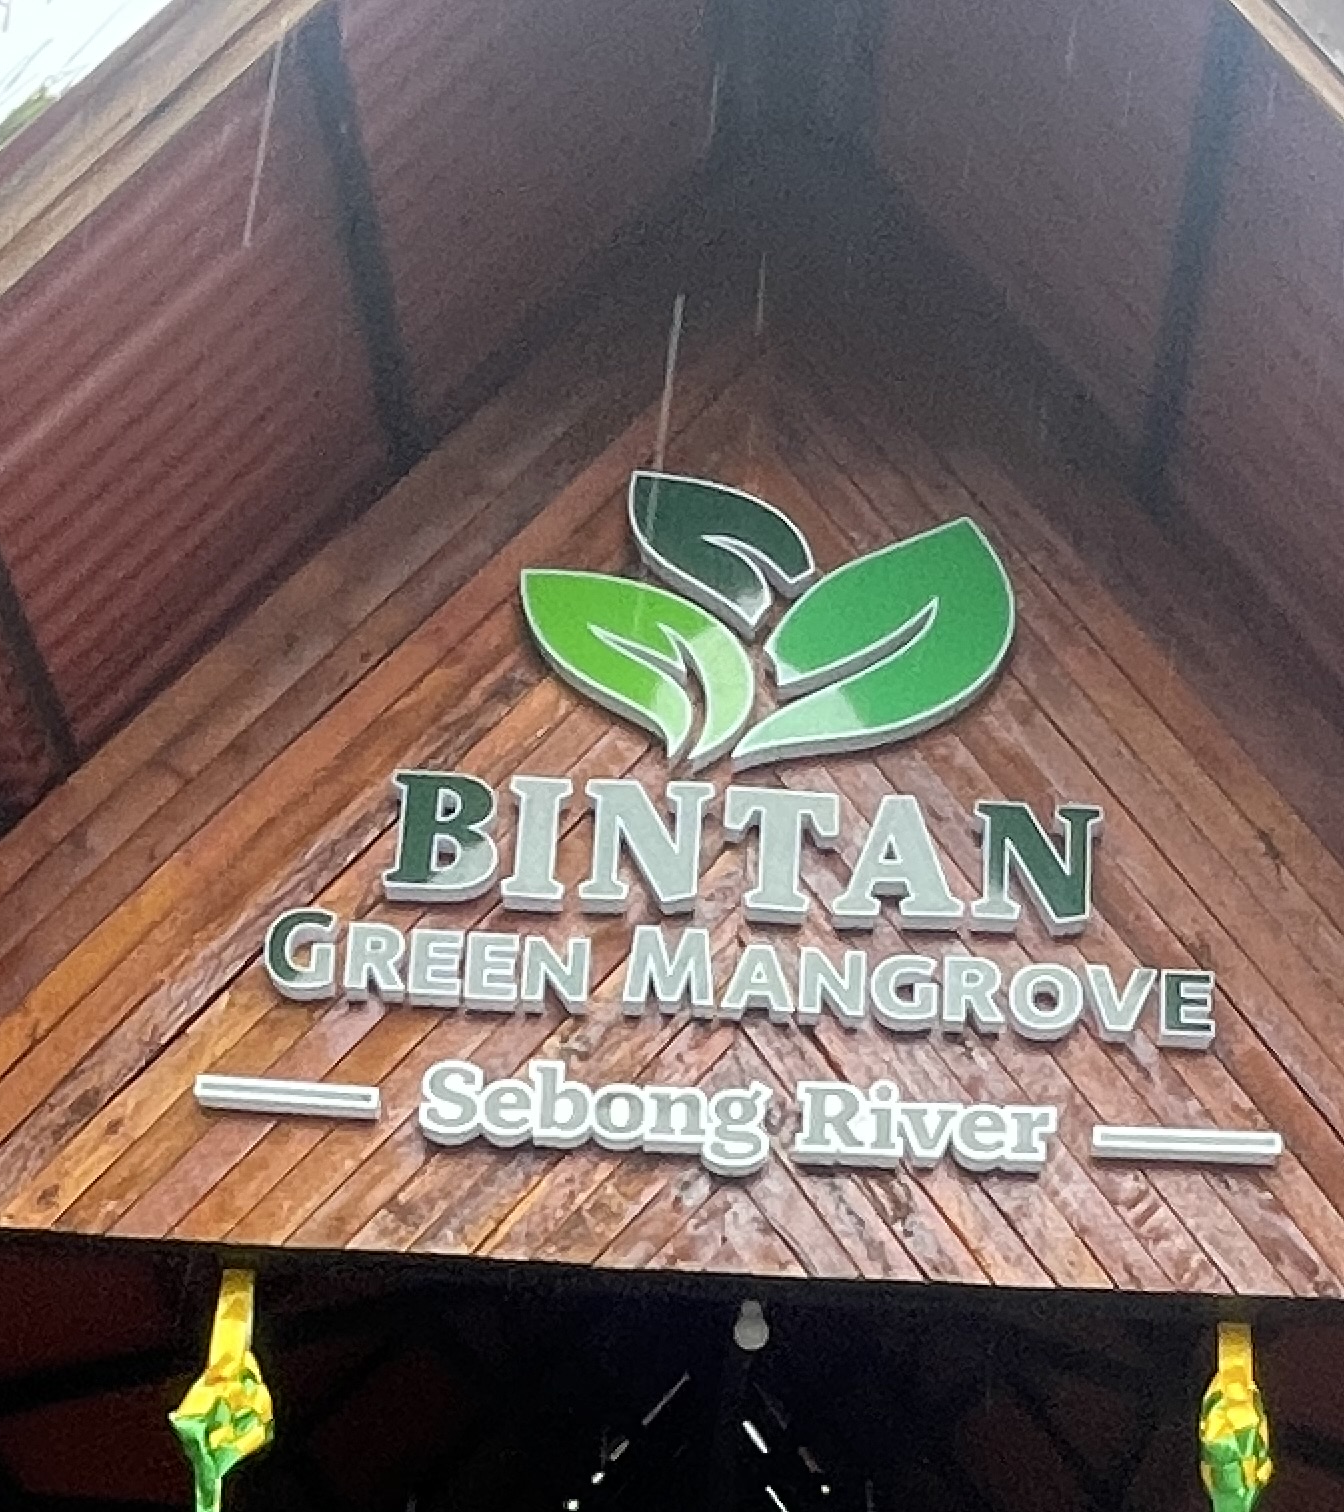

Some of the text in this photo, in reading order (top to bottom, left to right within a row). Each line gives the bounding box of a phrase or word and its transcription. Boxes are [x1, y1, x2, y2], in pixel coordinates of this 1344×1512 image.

[383, 769, 1103, 935] BINTAN
[265, 908, 1215, 1047] GREEN MANGROVE
[419, 1060, 1059, 1176] Sebong River
